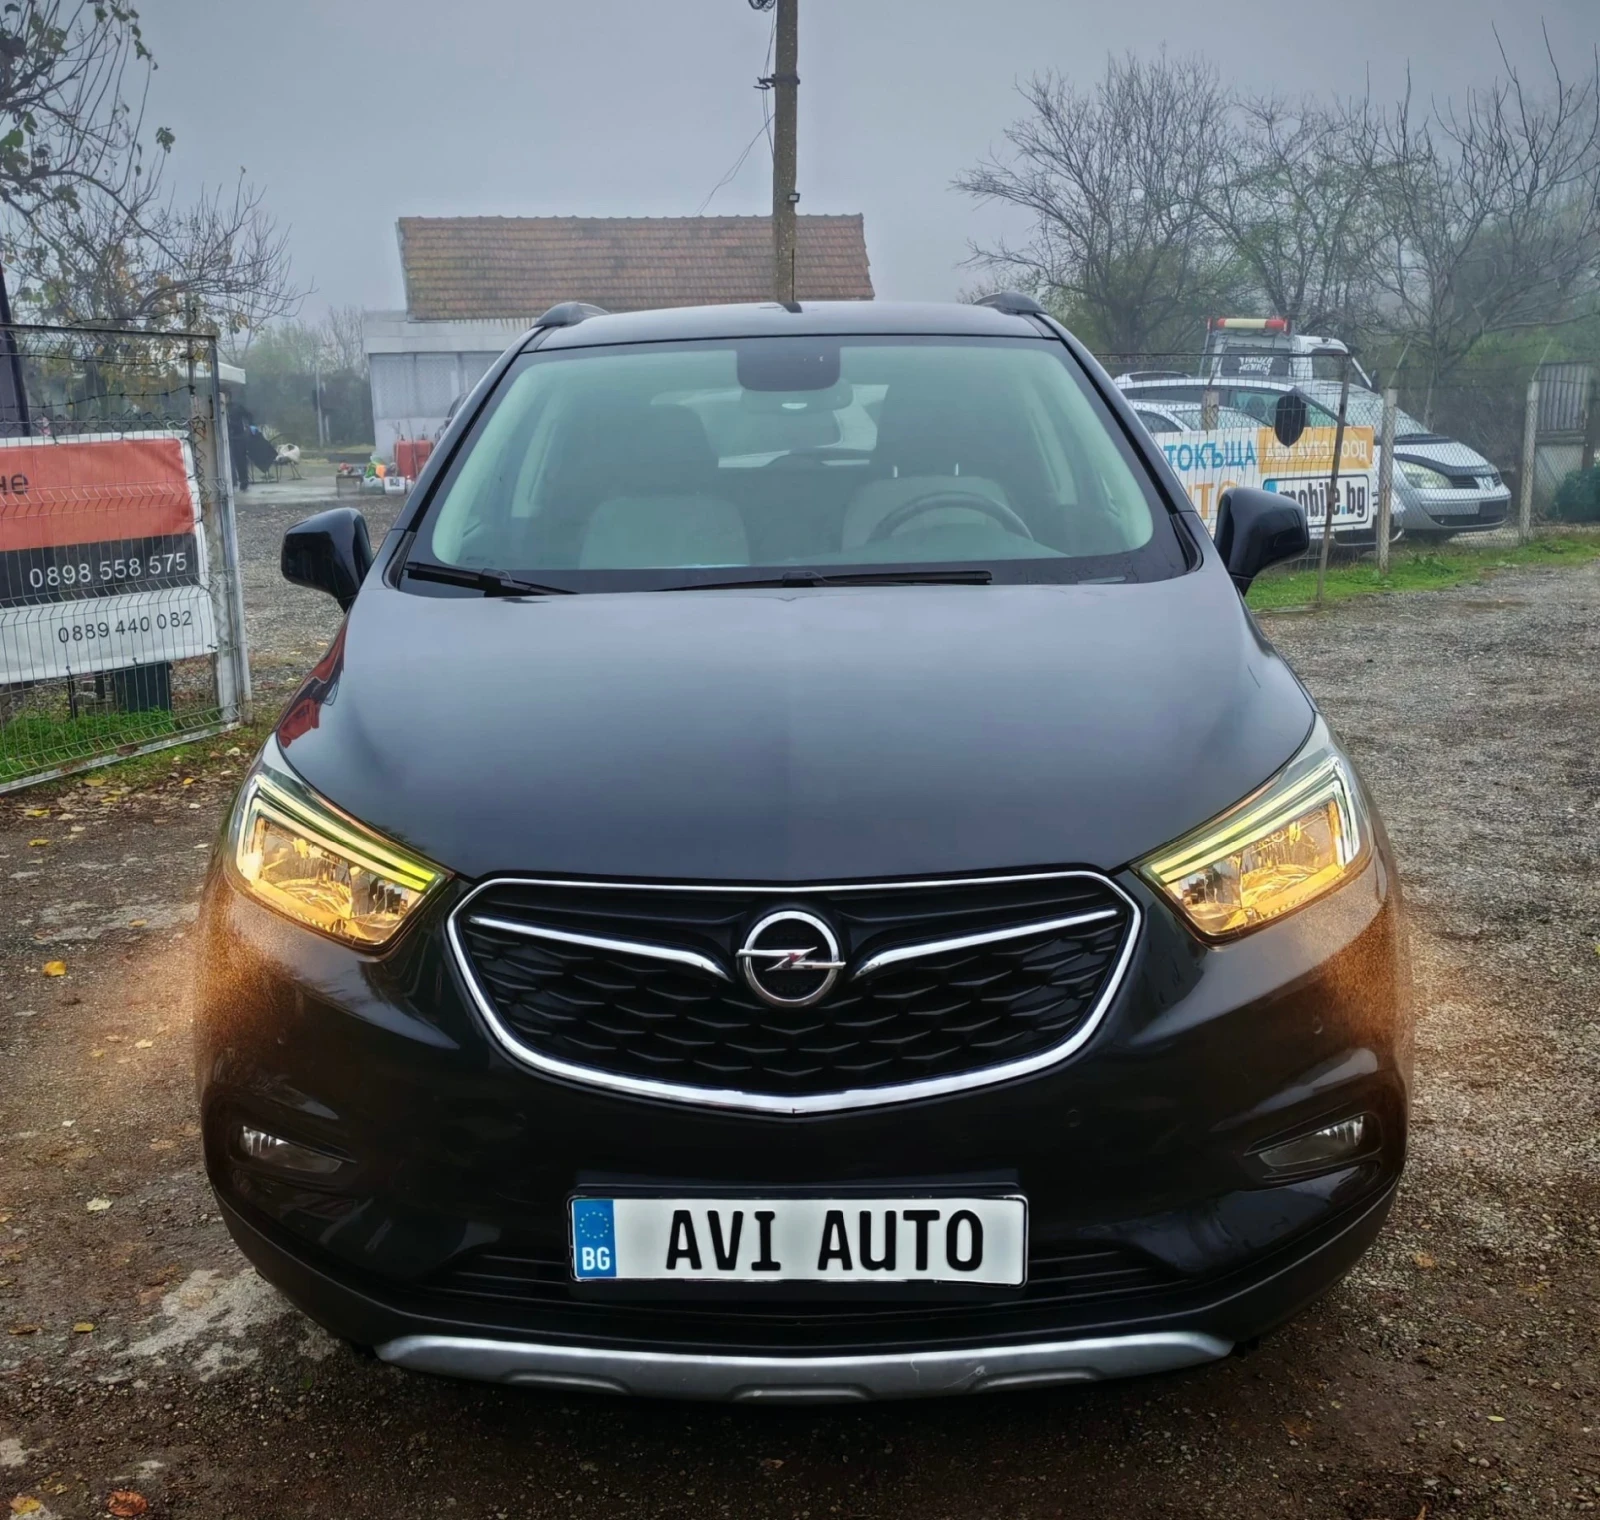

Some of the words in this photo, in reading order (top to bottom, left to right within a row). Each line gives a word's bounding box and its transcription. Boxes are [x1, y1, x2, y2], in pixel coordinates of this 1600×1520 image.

[1333, 440, 1367, 461] ООД
[1279, 480, 1366, 518] obile.bg
[29, 563, 91, 588] 0898
[100, 557, 142, 580] 558
[149, 552, 187, 575] 575
[58, 621, 110, 643] 0889
[115, 616, 150, 635] 440
[156, 610, 193, 630] 082
[666, 1210, 781, 1271] AVI
[817, 1209, 984, 1272] AUTO
[582, 1246, 610, 1270] BG
